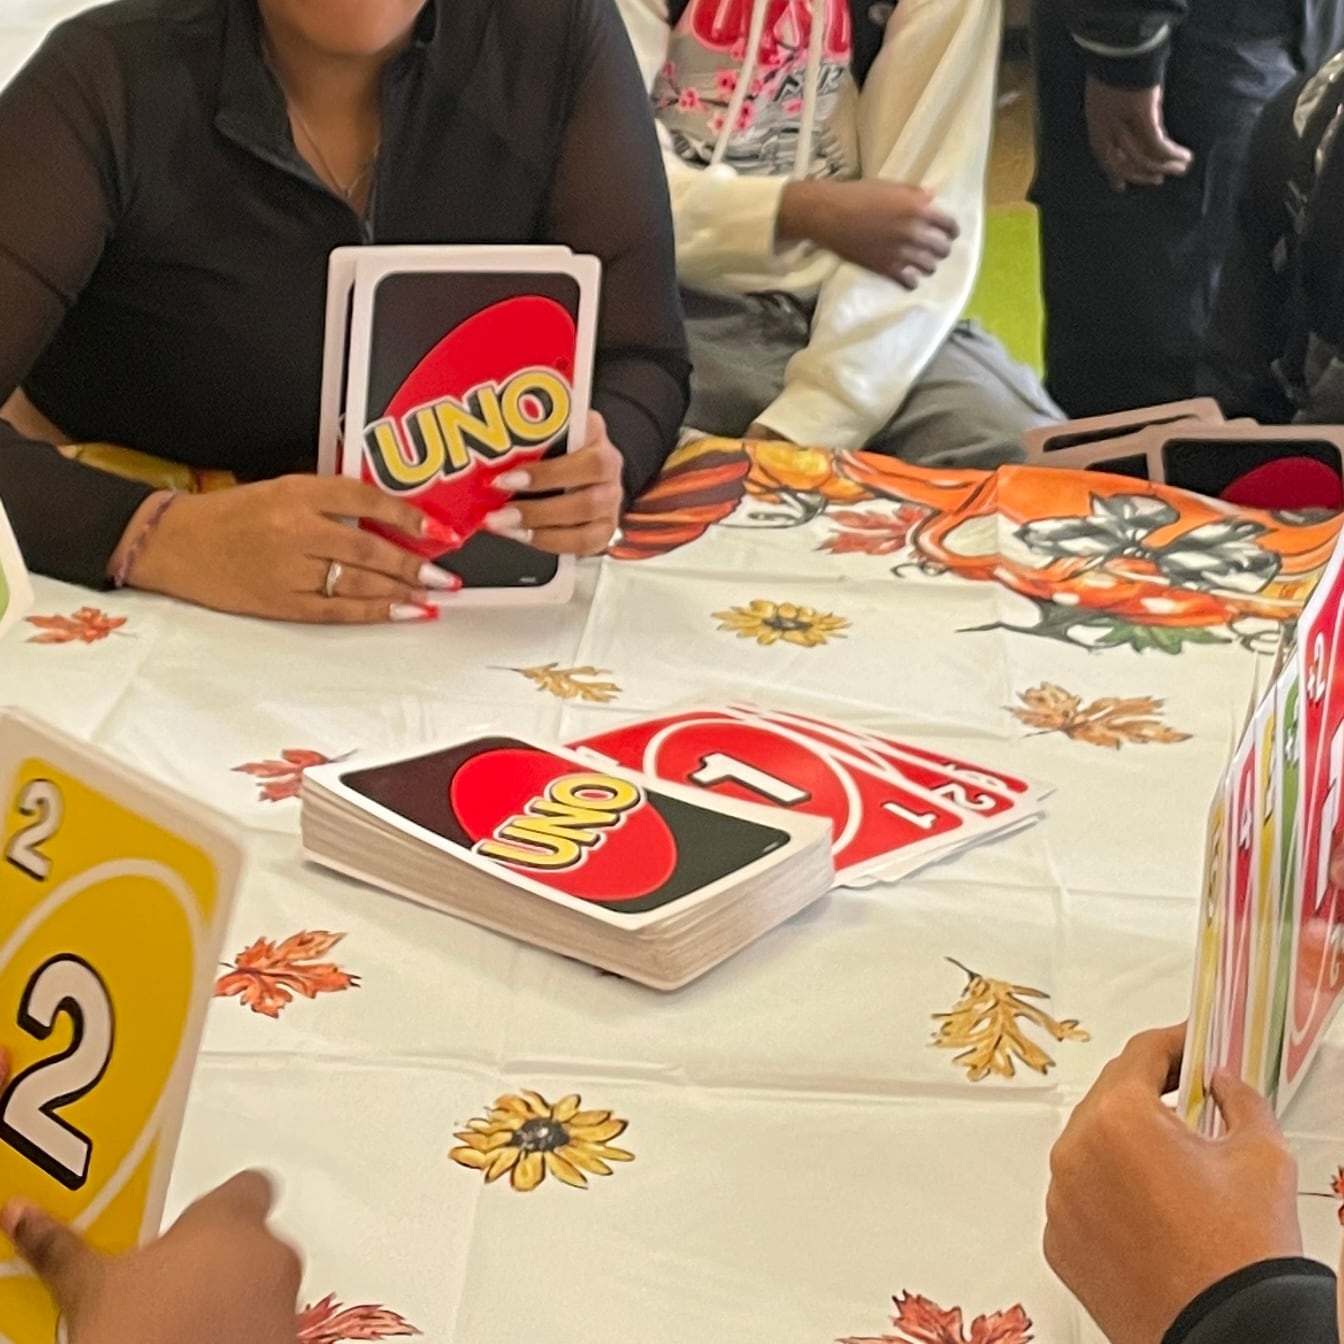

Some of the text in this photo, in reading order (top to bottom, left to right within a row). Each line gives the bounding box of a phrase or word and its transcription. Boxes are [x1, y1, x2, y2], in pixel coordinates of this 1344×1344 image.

[363, 366, 572, 495] UNO
[6, 777, 64, 882] 2
[470, 772, 648, 873] UNO
[688, 752, 812, 805] 1
